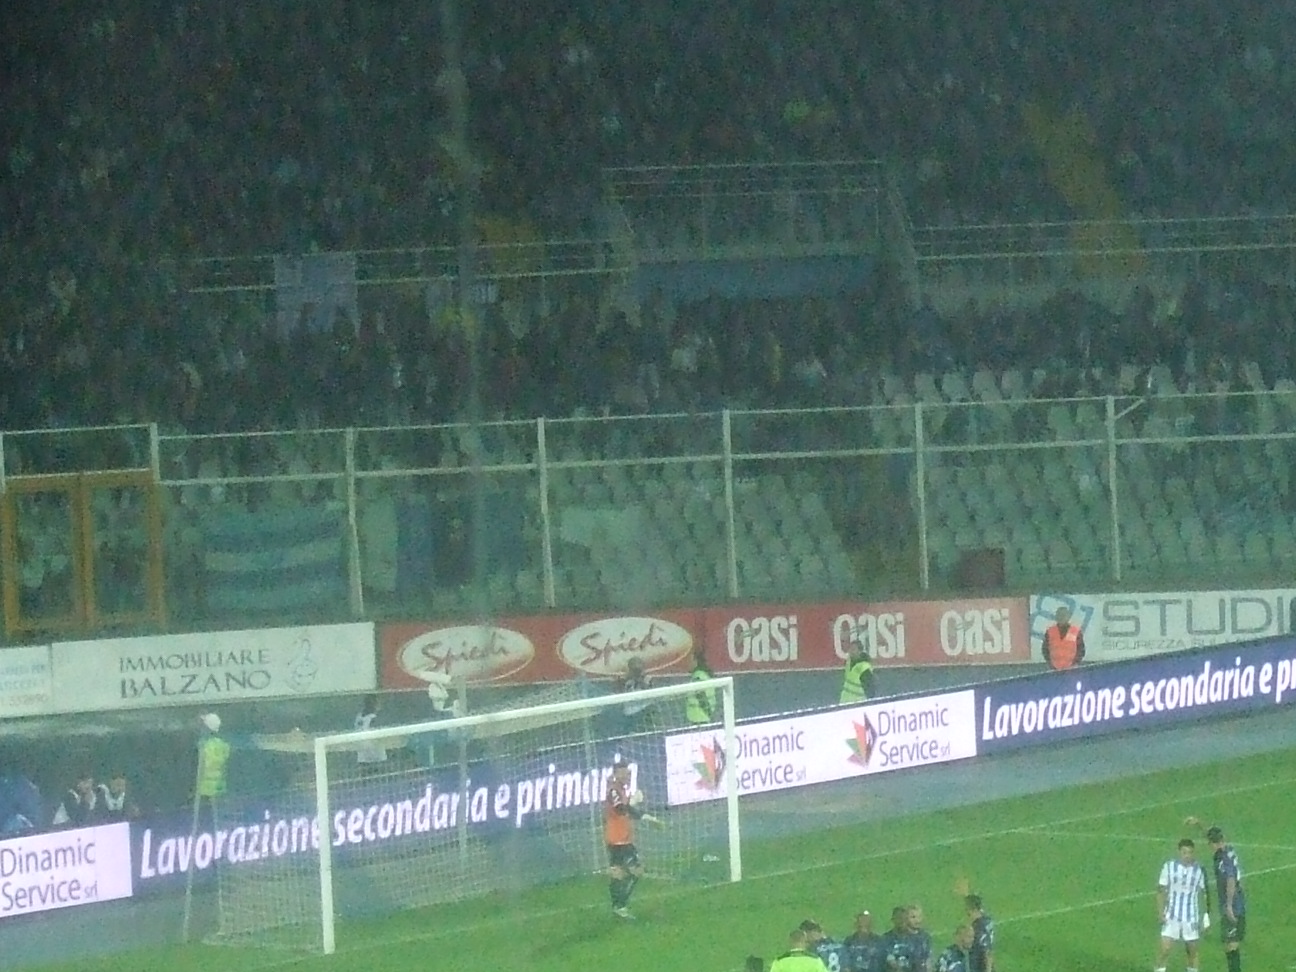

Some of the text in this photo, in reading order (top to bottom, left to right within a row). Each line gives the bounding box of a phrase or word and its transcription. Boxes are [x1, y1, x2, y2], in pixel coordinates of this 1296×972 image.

[119, 649, 272, 673] IMMOBILIARE
[120, 670, 272, 699] BALZANO
[982, 681, 1125, 740] Lavorazione
[1128, 656, 1255, 714] secondaria
[1258, 671, 1272, 694] e
[877, 703, 949, 737] Dinamic
[879, 737, 938, 767] Service
[333, 779, 487, 848] secondaria
[494, 783, 511, 819] e
[0, 838, 96, 877] Dinamic
[2, 876, 81, 912] Service
